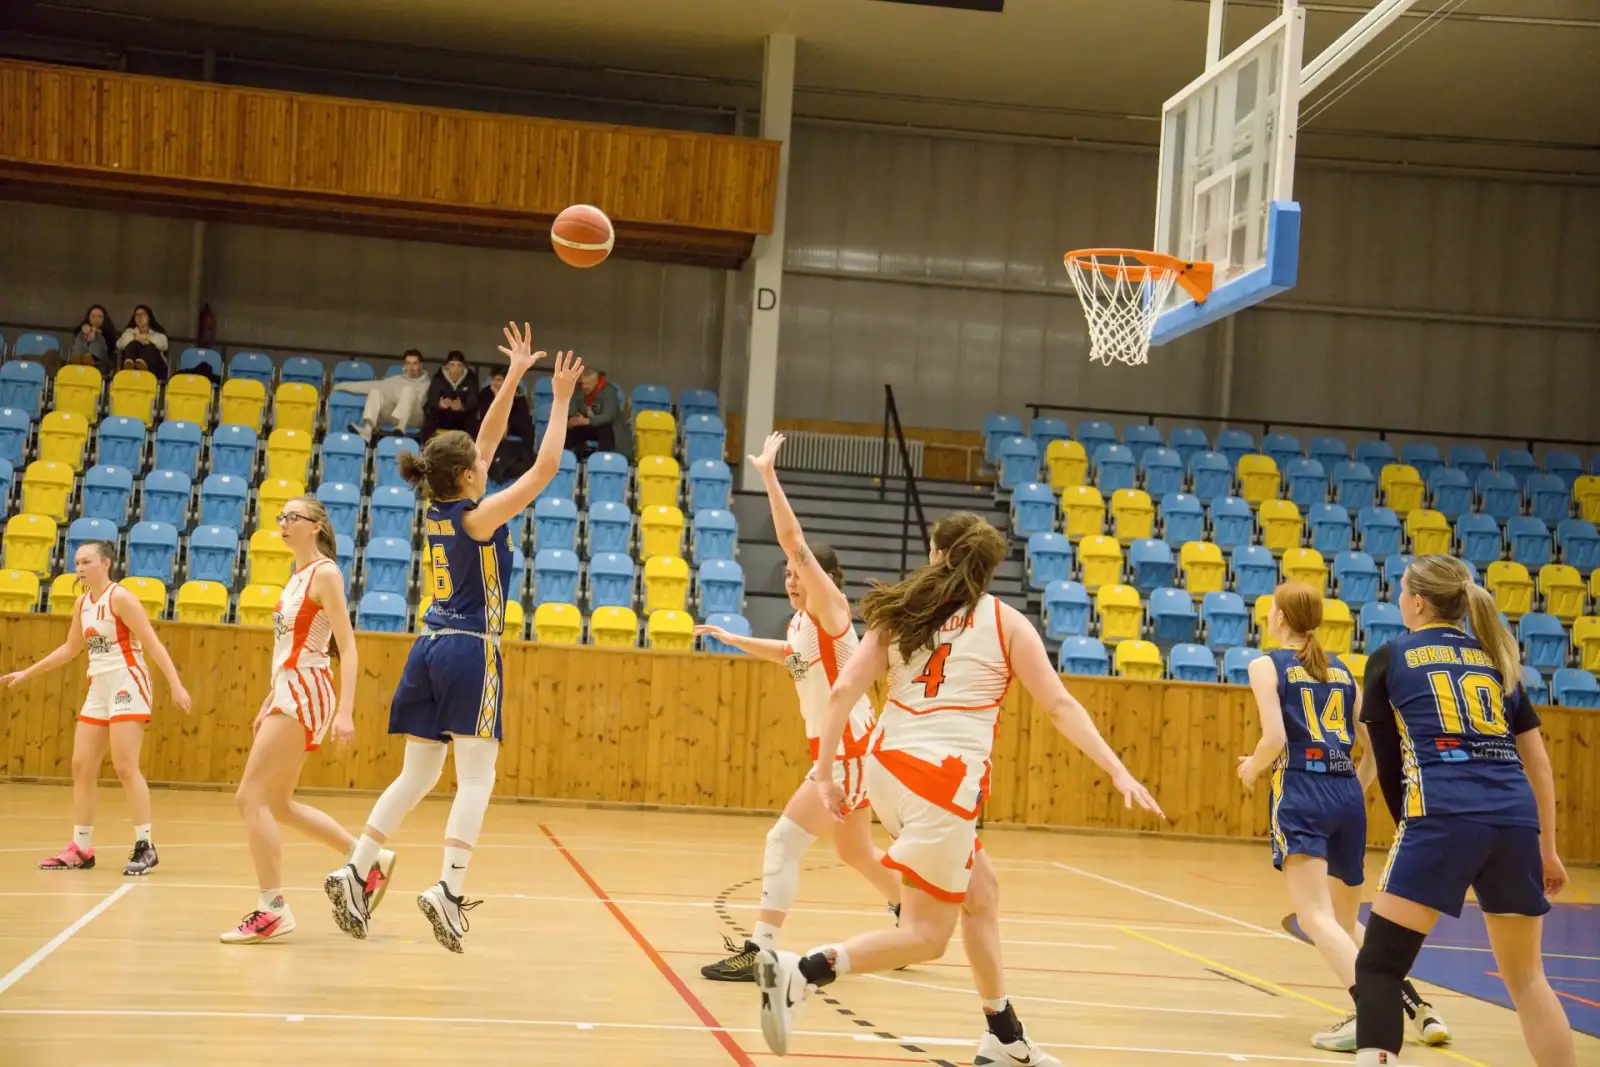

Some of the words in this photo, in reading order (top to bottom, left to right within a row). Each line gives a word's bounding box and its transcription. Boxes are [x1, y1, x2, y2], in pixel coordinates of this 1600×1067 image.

[758, 288, 776, 310] D
[432, 544, 454, 601] 6
[96, 604, 105, 621] 11
[911, 643, 952, 698] 4
[1404, 645, 1462, 668] SOKOL
[1300, 688, 1351, 744] 14
[1427, 671, 1509, 737] 10
